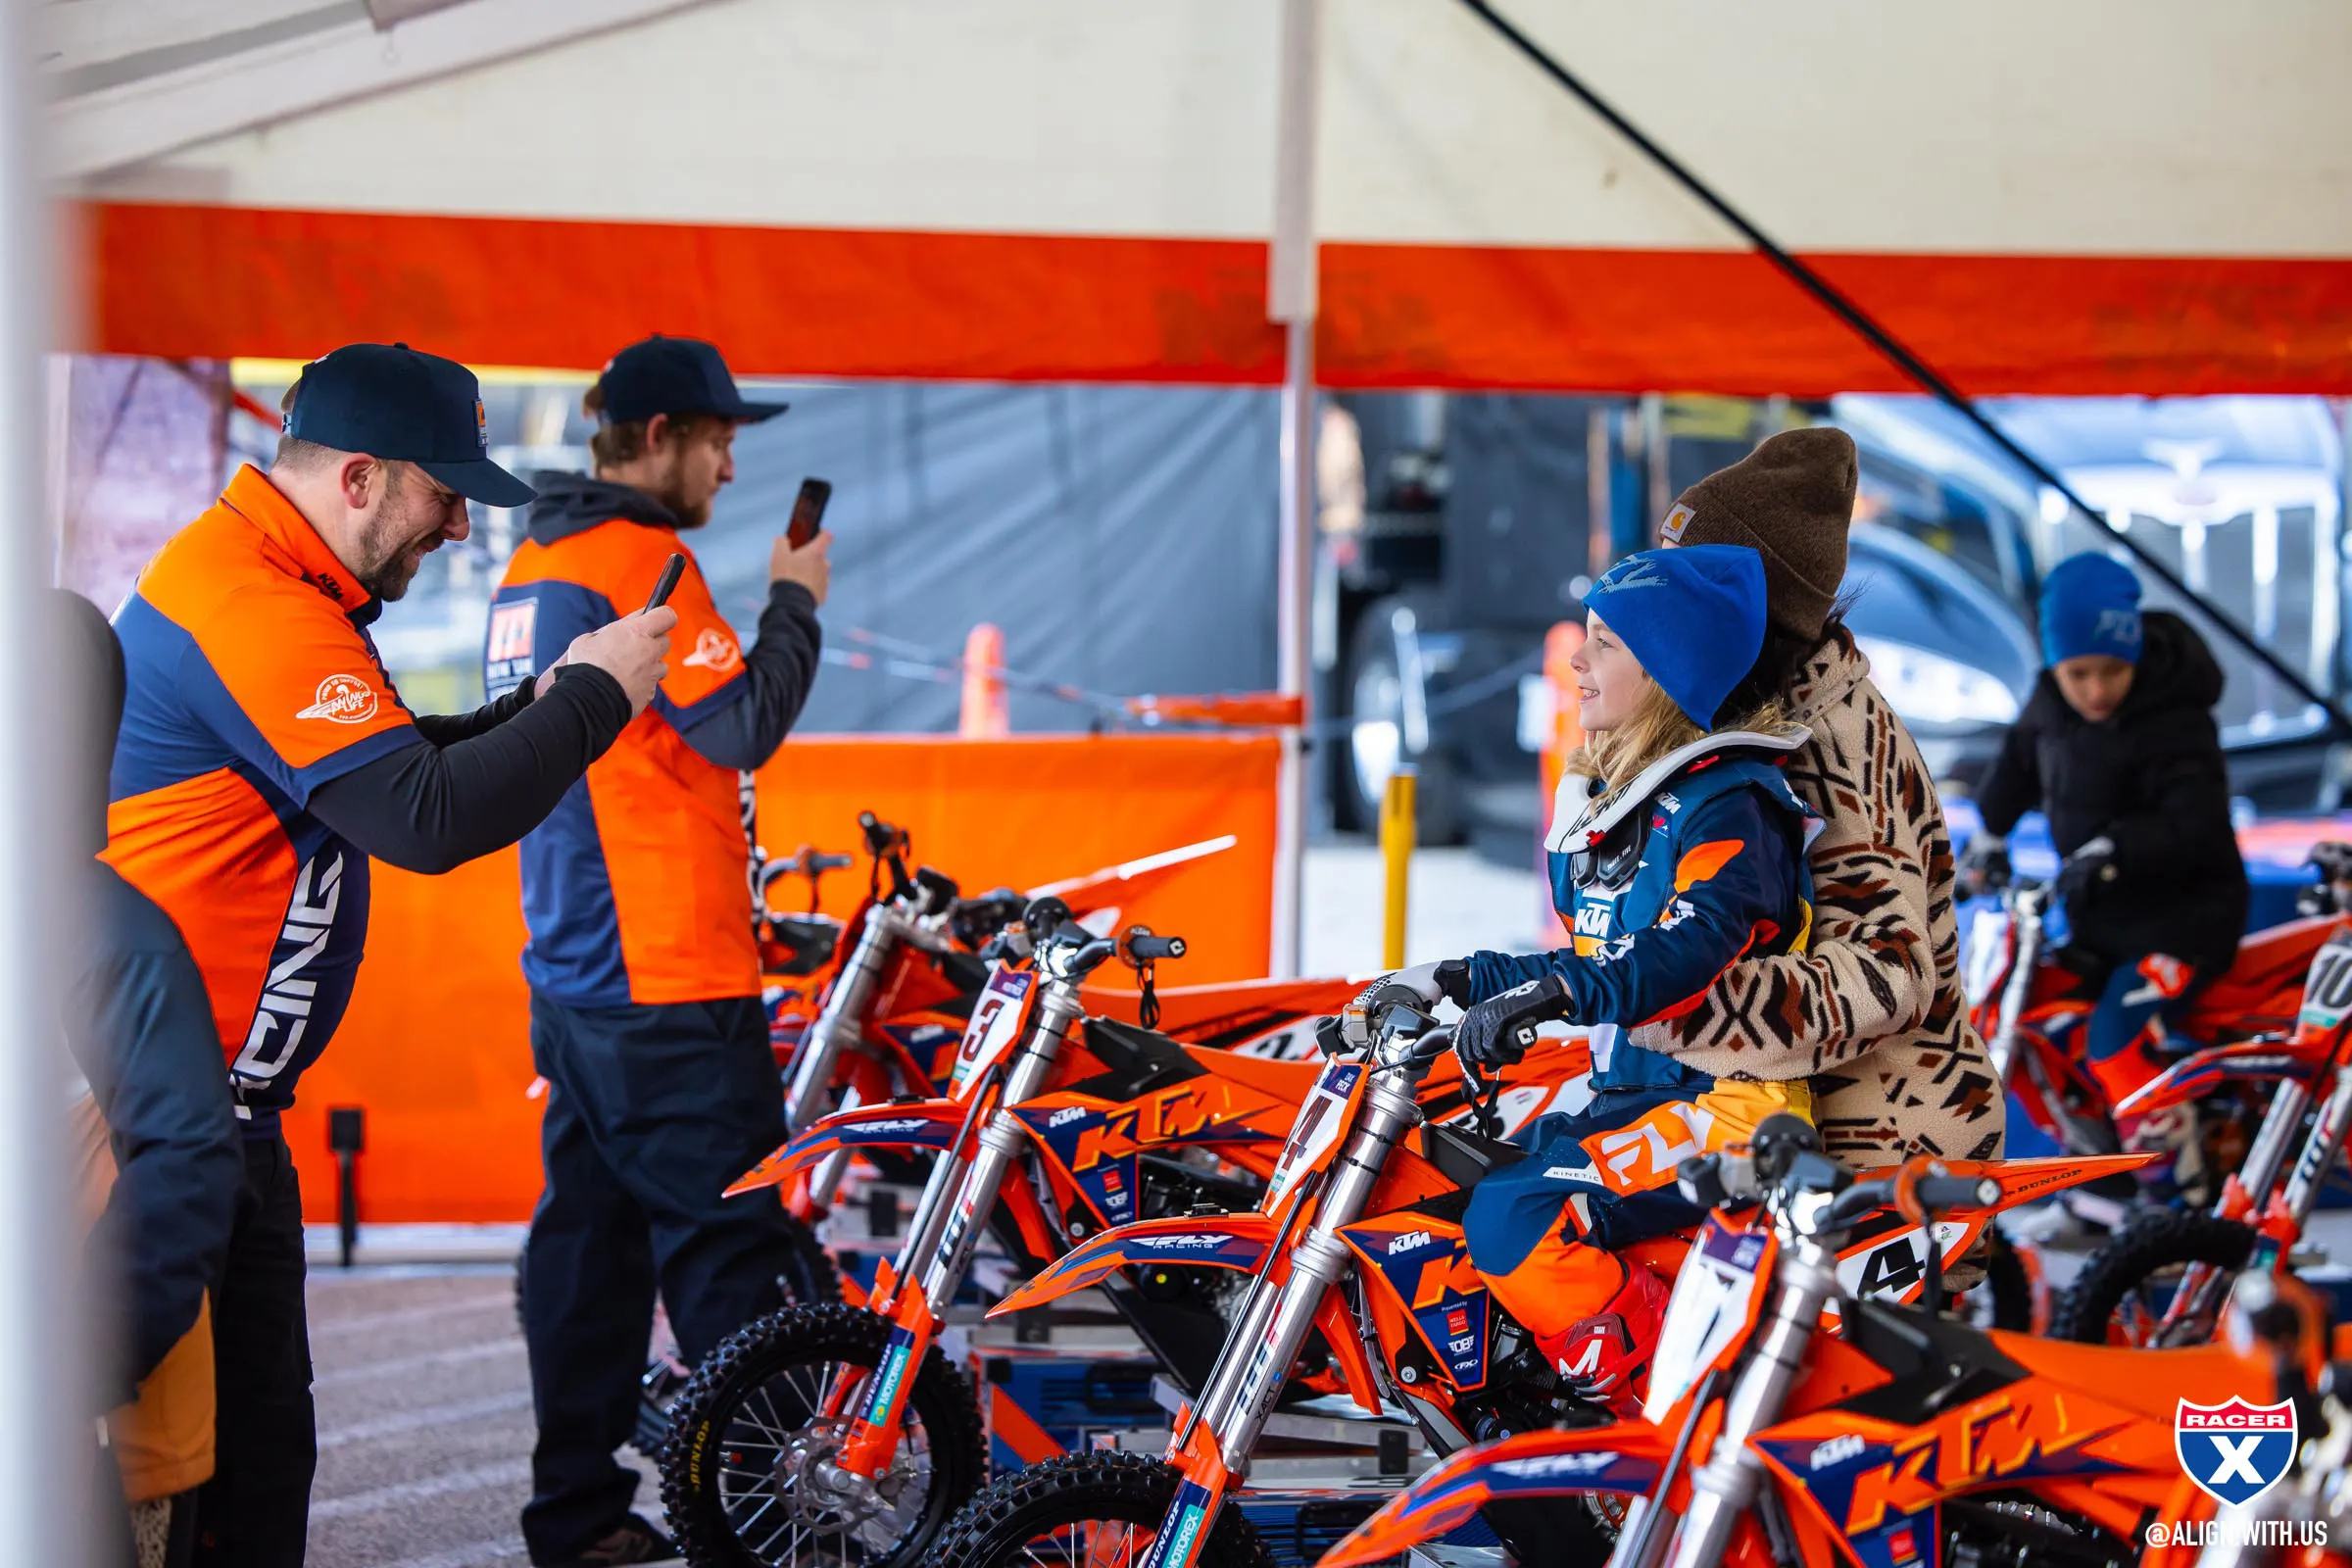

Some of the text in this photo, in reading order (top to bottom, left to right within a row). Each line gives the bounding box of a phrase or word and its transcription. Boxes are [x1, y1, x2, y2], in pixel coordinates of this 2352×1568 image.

[1654, 792, 1682, 815] KTM
[1574, 902, 1612, 939] KTM
[962, 998, 1005, 1063] 3
[1048, 1105, 1087, 1129] KTM
[1280, 1094, 1334, 1171] 4
[1600, 1102, 1715, 1187] FLY
[1552, 1169, 1600, 1183] KINETIC
[2018, 1169, 2083, 1194] DUNLOP
[1128, 1234, 1235, 1248] FLY
[1152, 1242, 1213, 1250] RACING
[1388, 1230, 1431, 1256] KTM
[1857, 1236, 1927, 1295] 4
[1450, 1319, 1466, 1328] FARGO
[864, 1343, 893, 1406] DUNLOP
[878, 1352, 907, 1405] MOTOREX
[1254, 1386, 1277, 1422] XACT
[689, 1419, 710, 1485] DUNLOP
[1809, 1434, 1866, 1471] KTM
